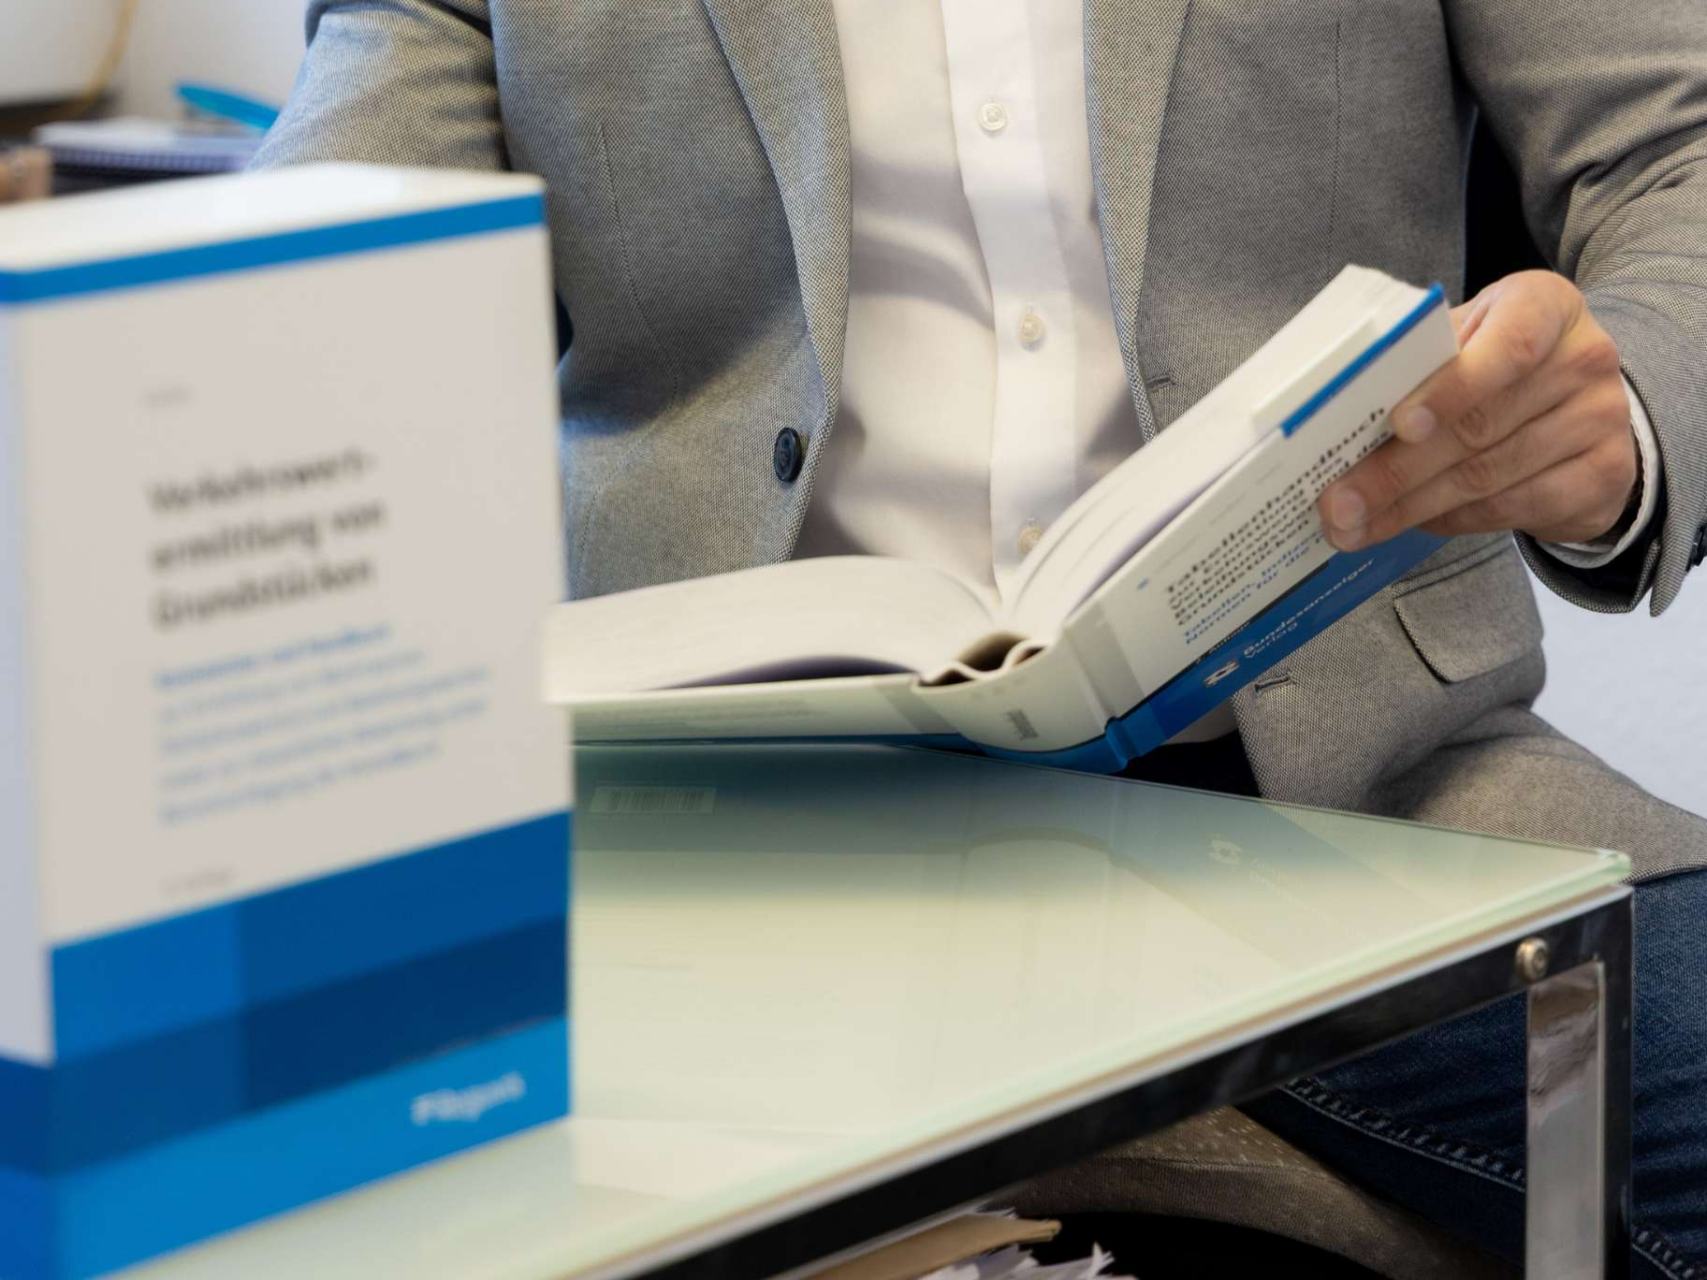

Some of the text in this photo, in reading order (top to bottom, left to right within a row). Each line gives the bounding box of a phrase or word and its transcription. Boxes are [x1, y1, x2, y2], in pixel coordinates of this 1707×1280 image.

[1165, 405, 1385, 594] Tabellenhandbuch
[1168, 579, 1194, 603] zur
[1203, 486, 1305, 574] Ermittlung
[1309, 455, 1343, 485] des
[1171, 428, 1389, 612] Verkehrswerts und des
[1174, 498, 1320, 619] Beleihungswer
[1177, 516, 1309, 627] Grundstücken
[1184, 589, 1251, 646] Normen
[1283, 543, 1310, 567] die
[1242, 556, 1375, 656] Bundesanzeiger
[1244, 619, 1299, 661] Verlag
